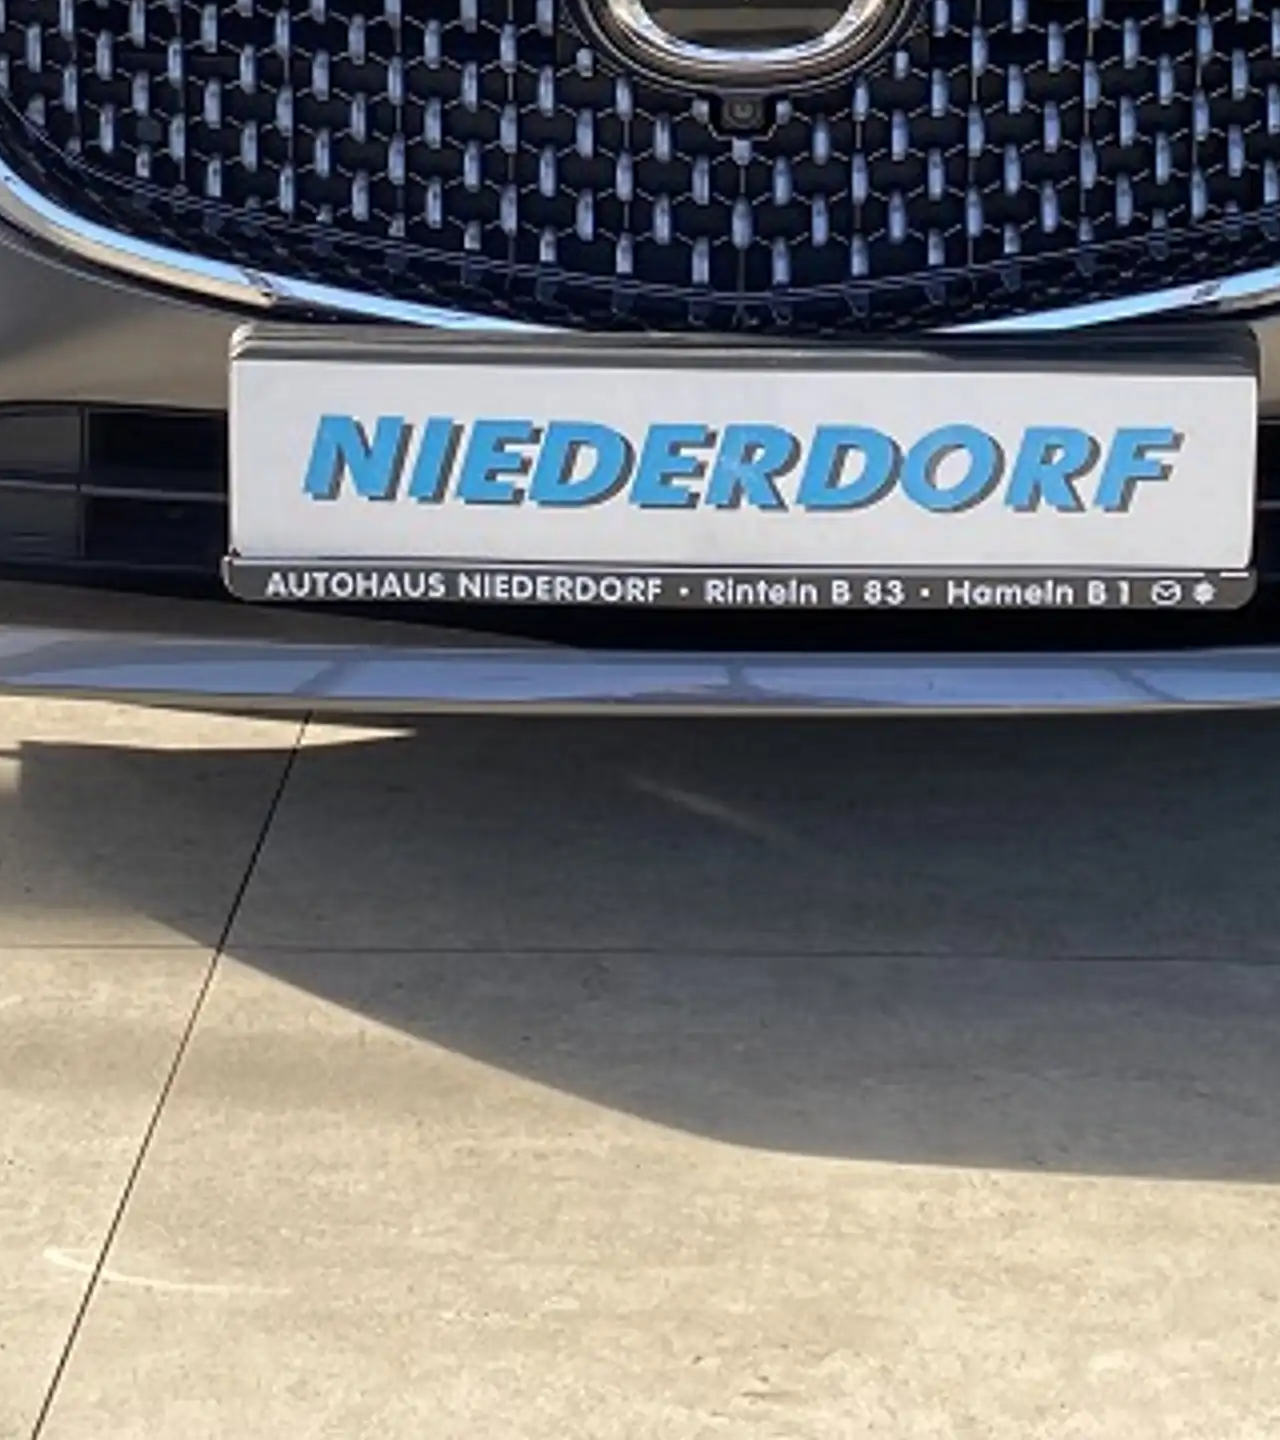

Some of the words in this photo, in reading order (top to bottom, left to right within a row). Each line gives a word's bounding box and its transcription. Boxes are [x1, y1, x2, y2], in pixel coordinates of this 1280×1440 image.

[301, 413, 1182, 513] NIEDERDORF
[264, 571, 446, 598] AUTOHAUS
[458, 574, 663, 602] NIEDERDORF
[704, 578, 817, 605] Rinteln
[831, 580, 851, 605] B
[864, 580, 905, 605] 83
[947, 580, 1074, 606] Hameln
[1087, 581, 1107, 606] B
